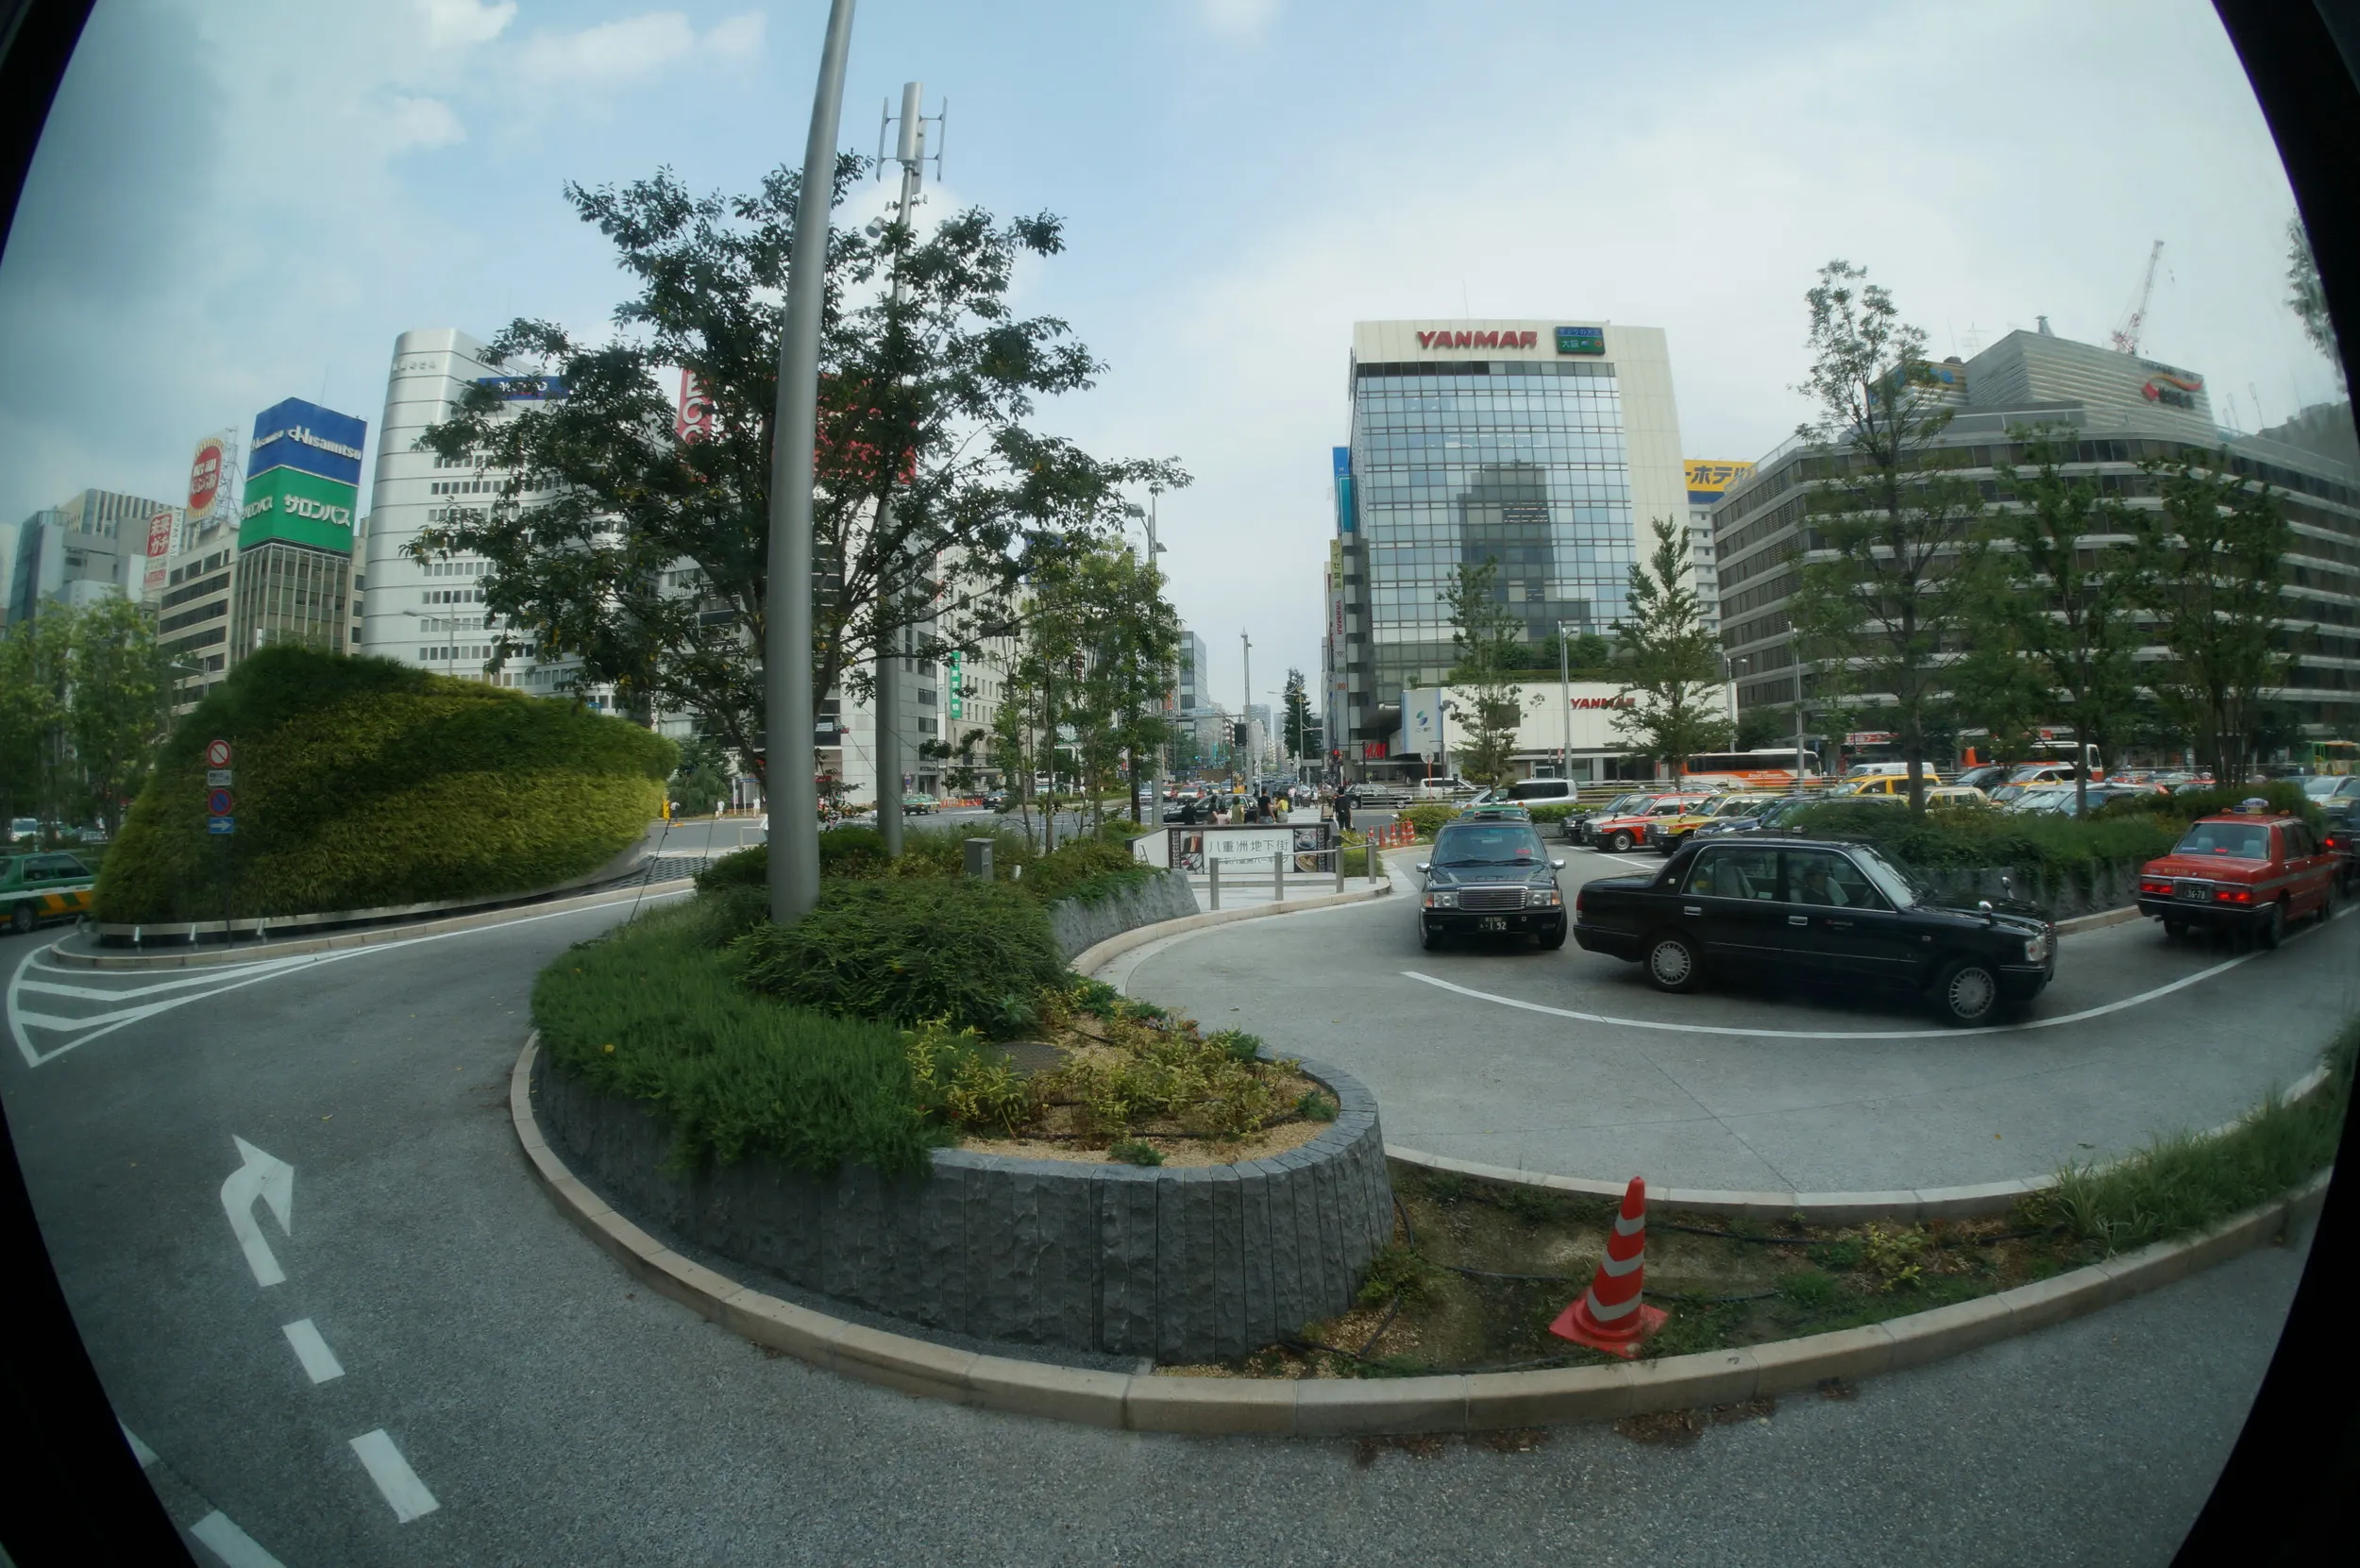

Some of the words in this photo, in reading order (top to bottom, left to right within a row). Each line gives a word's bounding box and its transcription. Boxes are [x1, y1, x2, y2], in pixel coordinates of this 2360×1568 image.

[1417, 330, 1538, 349] YANMAR
[287, 424, 362, 461] Hisamitsu
[284, 494, 350, 527] サロンパス
[1209, 839, 1289, 853] 八重洲地下街
